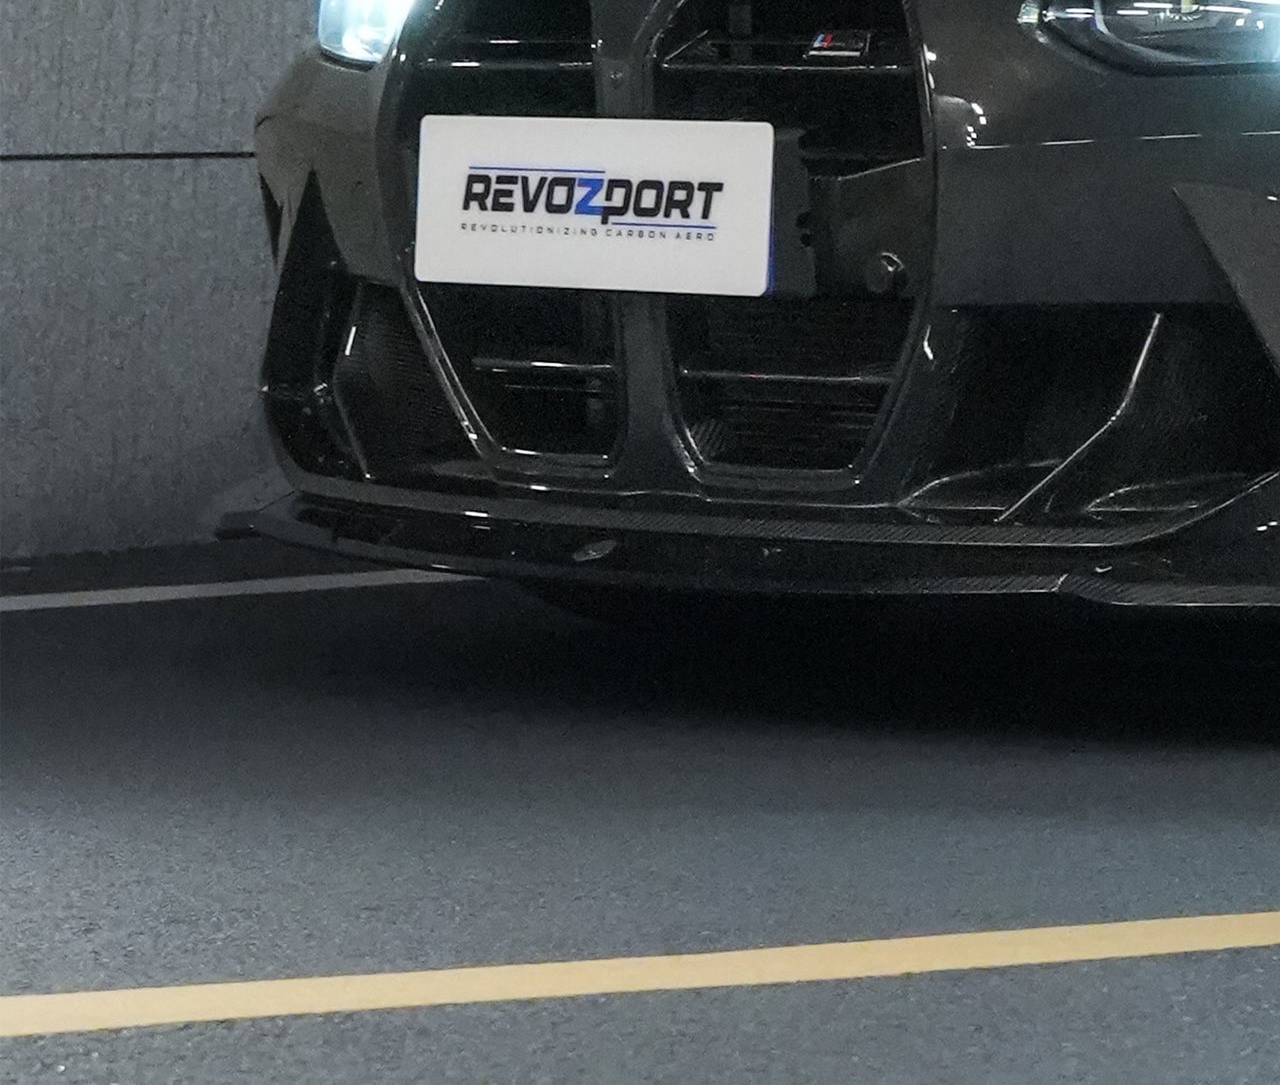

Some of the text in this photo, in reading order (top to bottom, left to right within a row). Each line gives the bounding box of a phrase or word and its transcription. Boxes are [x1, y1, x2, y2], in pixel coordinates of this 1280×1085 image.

[462, 173, 724, 225] REVOZPORT
[460, 222, 715, 242] REVOLUTIONIZING CARBON AERO
